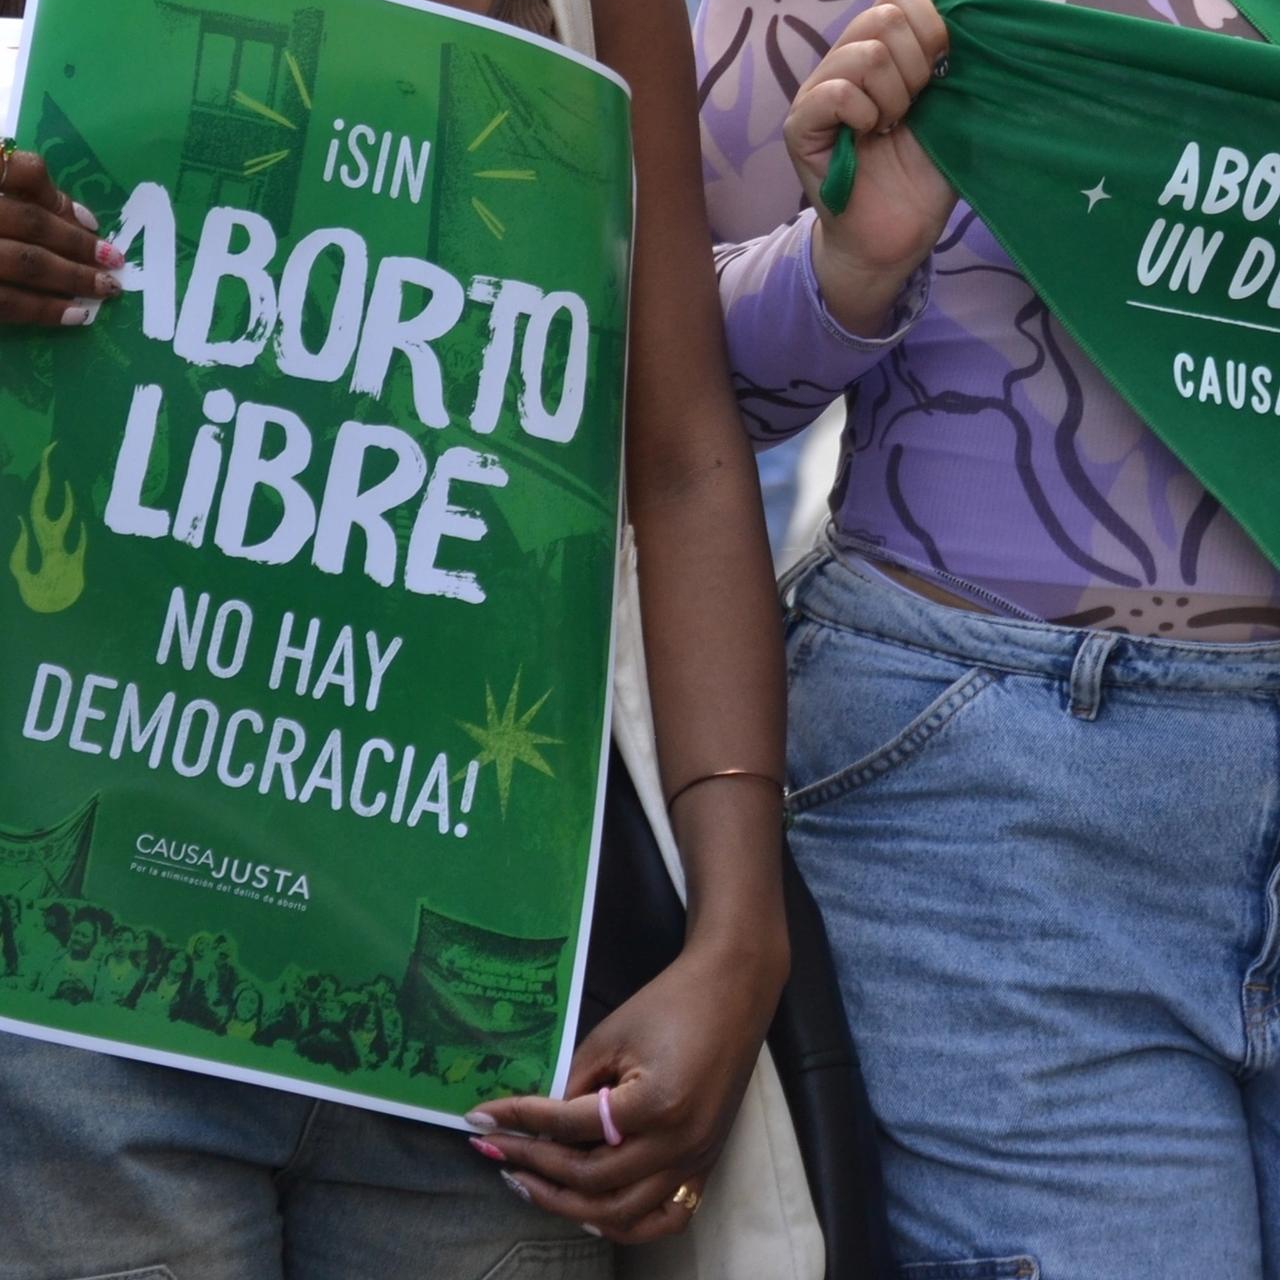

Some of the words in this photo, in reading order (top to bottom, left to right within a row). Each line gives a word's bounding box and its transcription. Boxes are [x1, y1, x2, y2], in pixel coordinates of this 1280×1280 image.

[323, 117, 432, 205] ¡SIN
[1136, 217, 1224, 295] UN
[100, 182, 590, 443] ABORTO
[155, 585, 254, 680] NO
[268, 610, 404, 713] HAY
[21, 662, 481, 839] DEMOCRACIA!
[129, 862, 146, 874] Por
[148, 865, 158, 877] la
[216, 883, 232, 894] del
[262, 894, 274, 905] de
[276, 896, 308, 913] aborto
